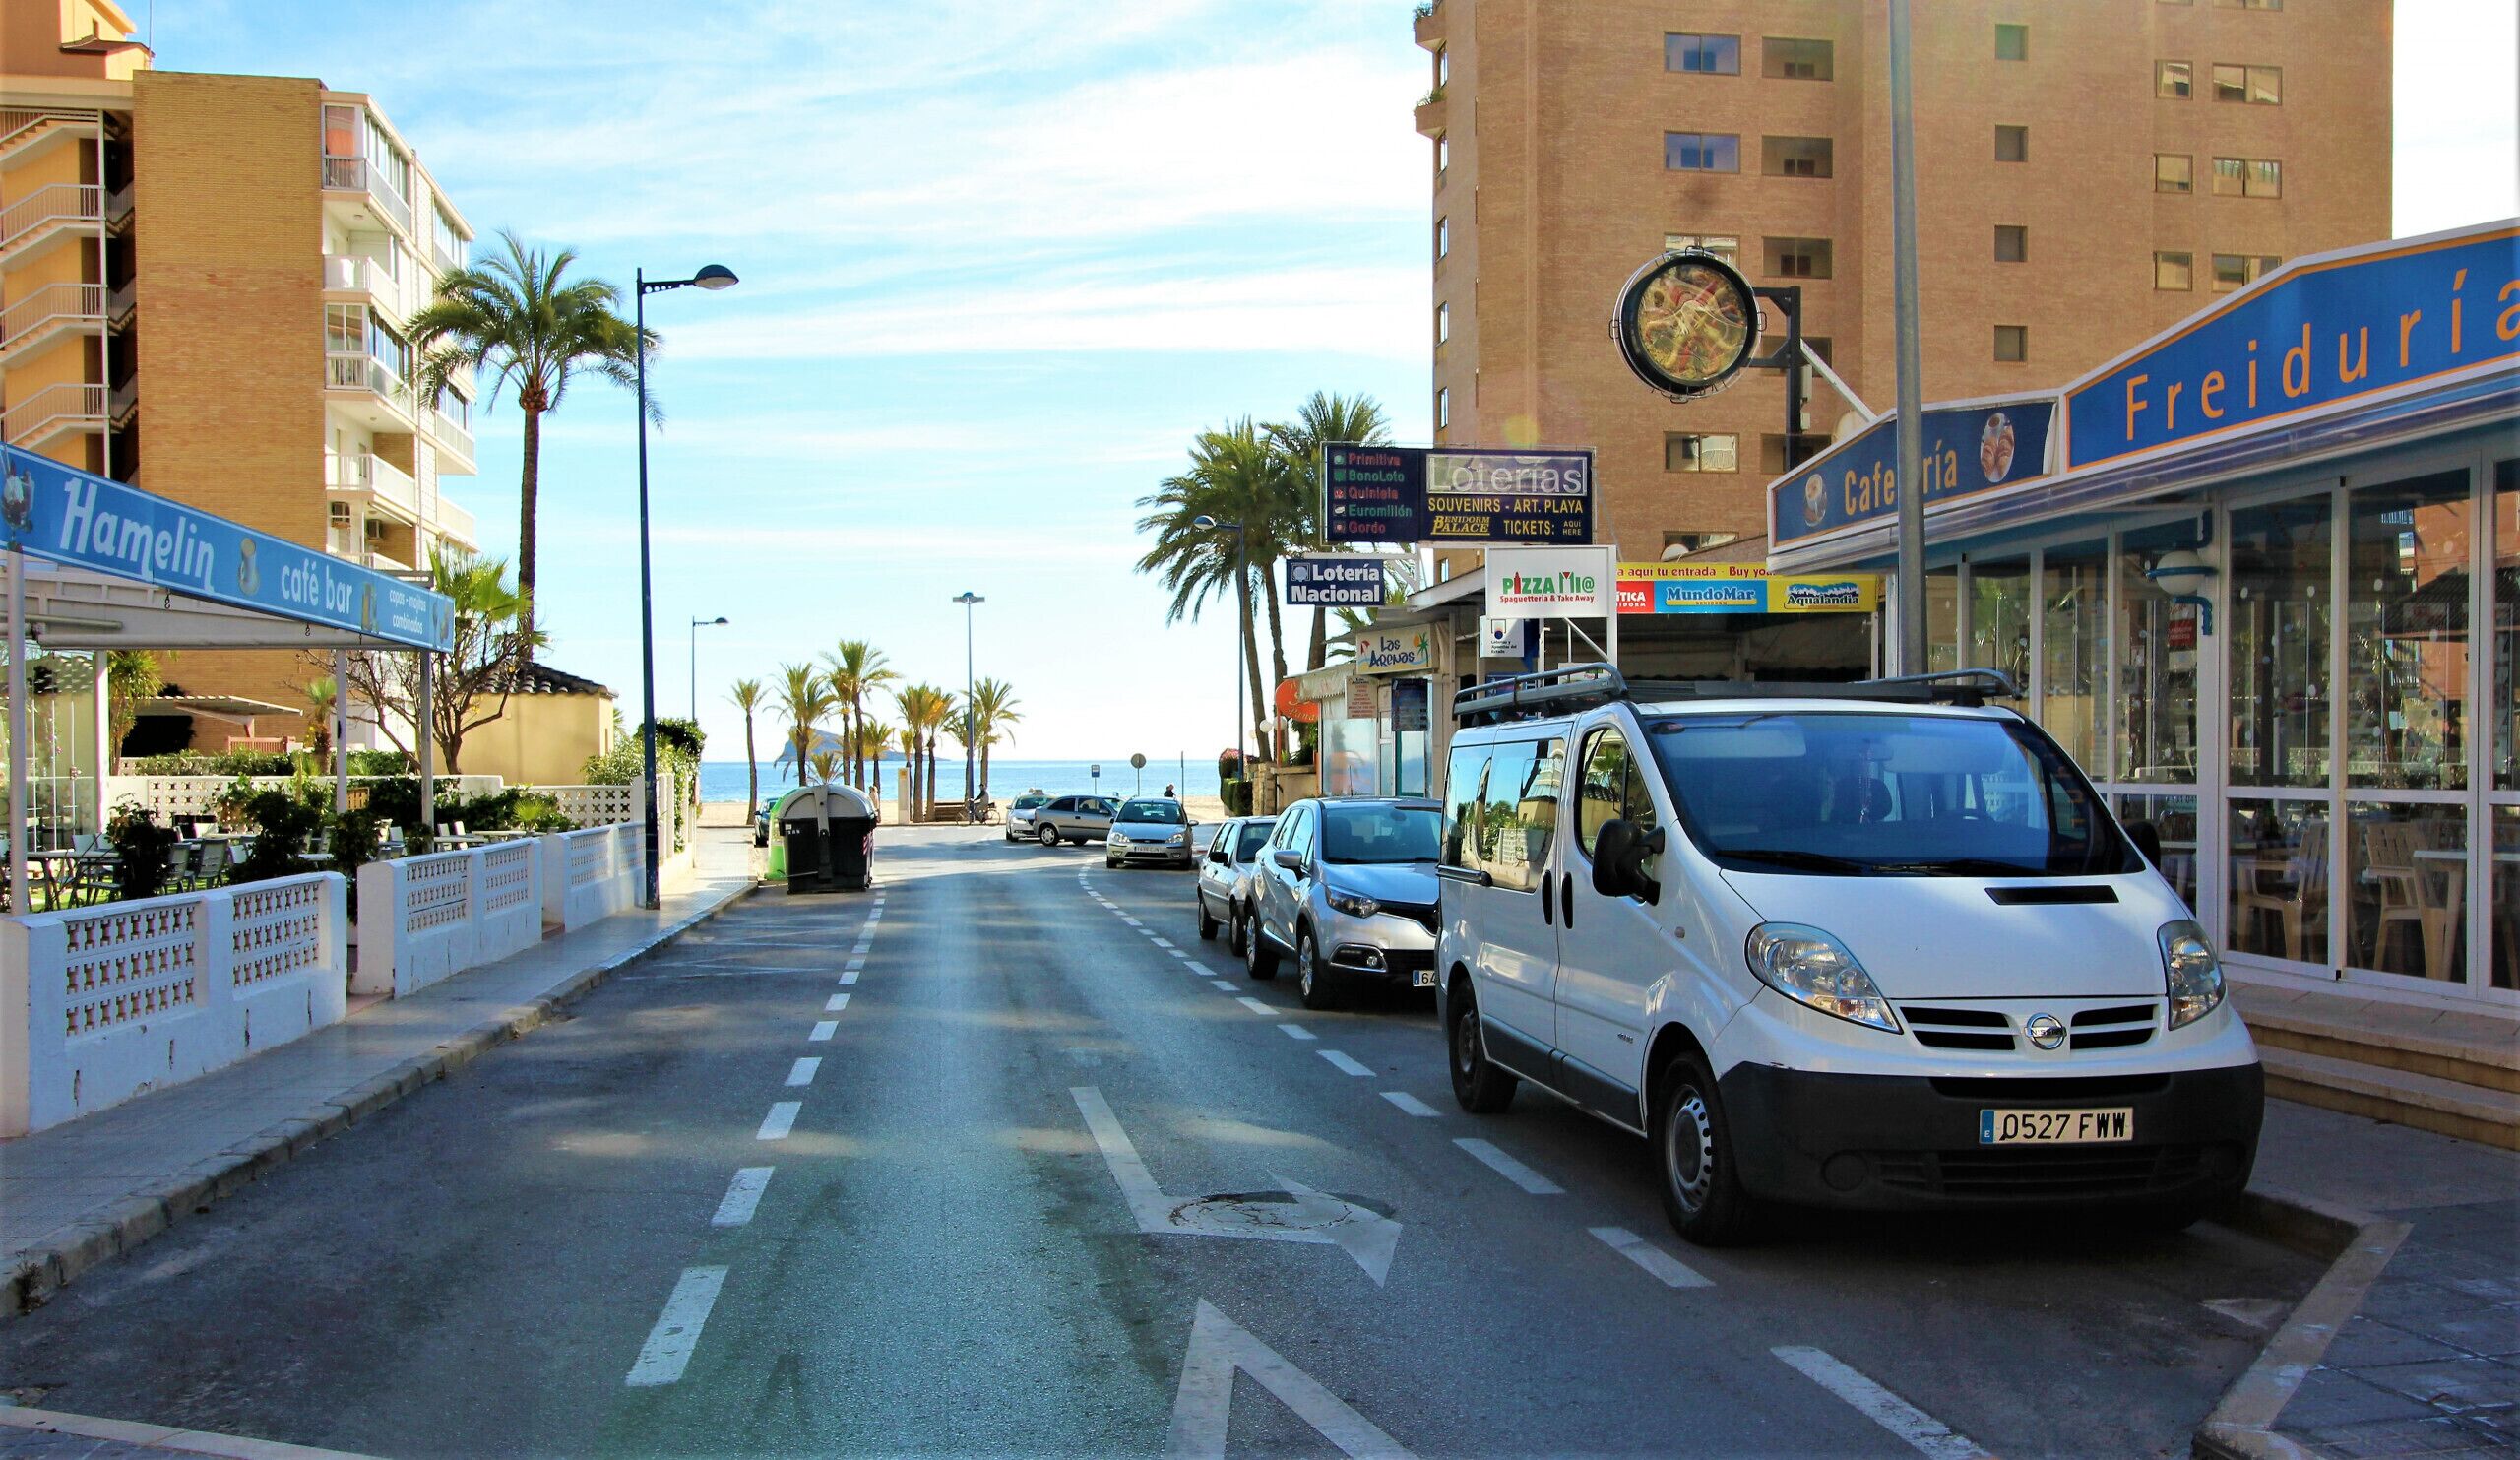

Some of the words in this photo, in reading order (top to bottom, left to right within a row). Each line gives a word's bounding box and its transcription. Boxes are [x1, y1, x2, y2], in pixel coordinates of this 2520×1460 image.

[2126, 268, 2520, 441] Freiduría
[1349, 453, 1401, 466] Primitiva
[1349, 470, 1405, 482] BonoLoto
[1845, 439, 1957, 516] Cafería
[1349, 486, 1399, 500] Quiniela
[1428, 498, 1501, 513] SOUVENIRS
[1514, 499, 1541, 513] ART.
[1544, 499, 1583, 514] PLAYA
[1349, 520, 1386, 533] Gordo
[1432, 522, 1489, 533] PALACE
[1434, 516, 1490, 527] BENIDORM
[1503, 520, 1554, 535] TICKETS:
[60, 477, 215, 593] Hamelin
[1312, 563, 1380, 582] Lotería
[1657, 567, 1668, 577] tu
[1671, 566, 1716, 577] entrada
[1729, 566, 1749, 578] Buy
[282, 562, 320, 606] café
[326, 566, 353, 614] bar
[1502, 571, 1555, 594] PIZZA
[1292, 584, 1380, 603] Nacional
[1499, 594, 1548, 603] Spaguetteria
[1666, 587, 1755, 601] MundoMar
[1787, 595, 1859, 606] Aqualandia
[1380, 636, 1400, 652] Las
[2000, 1113, 2071, 1140] 0527
[2078, 1112, 2126, 1139] FWW
